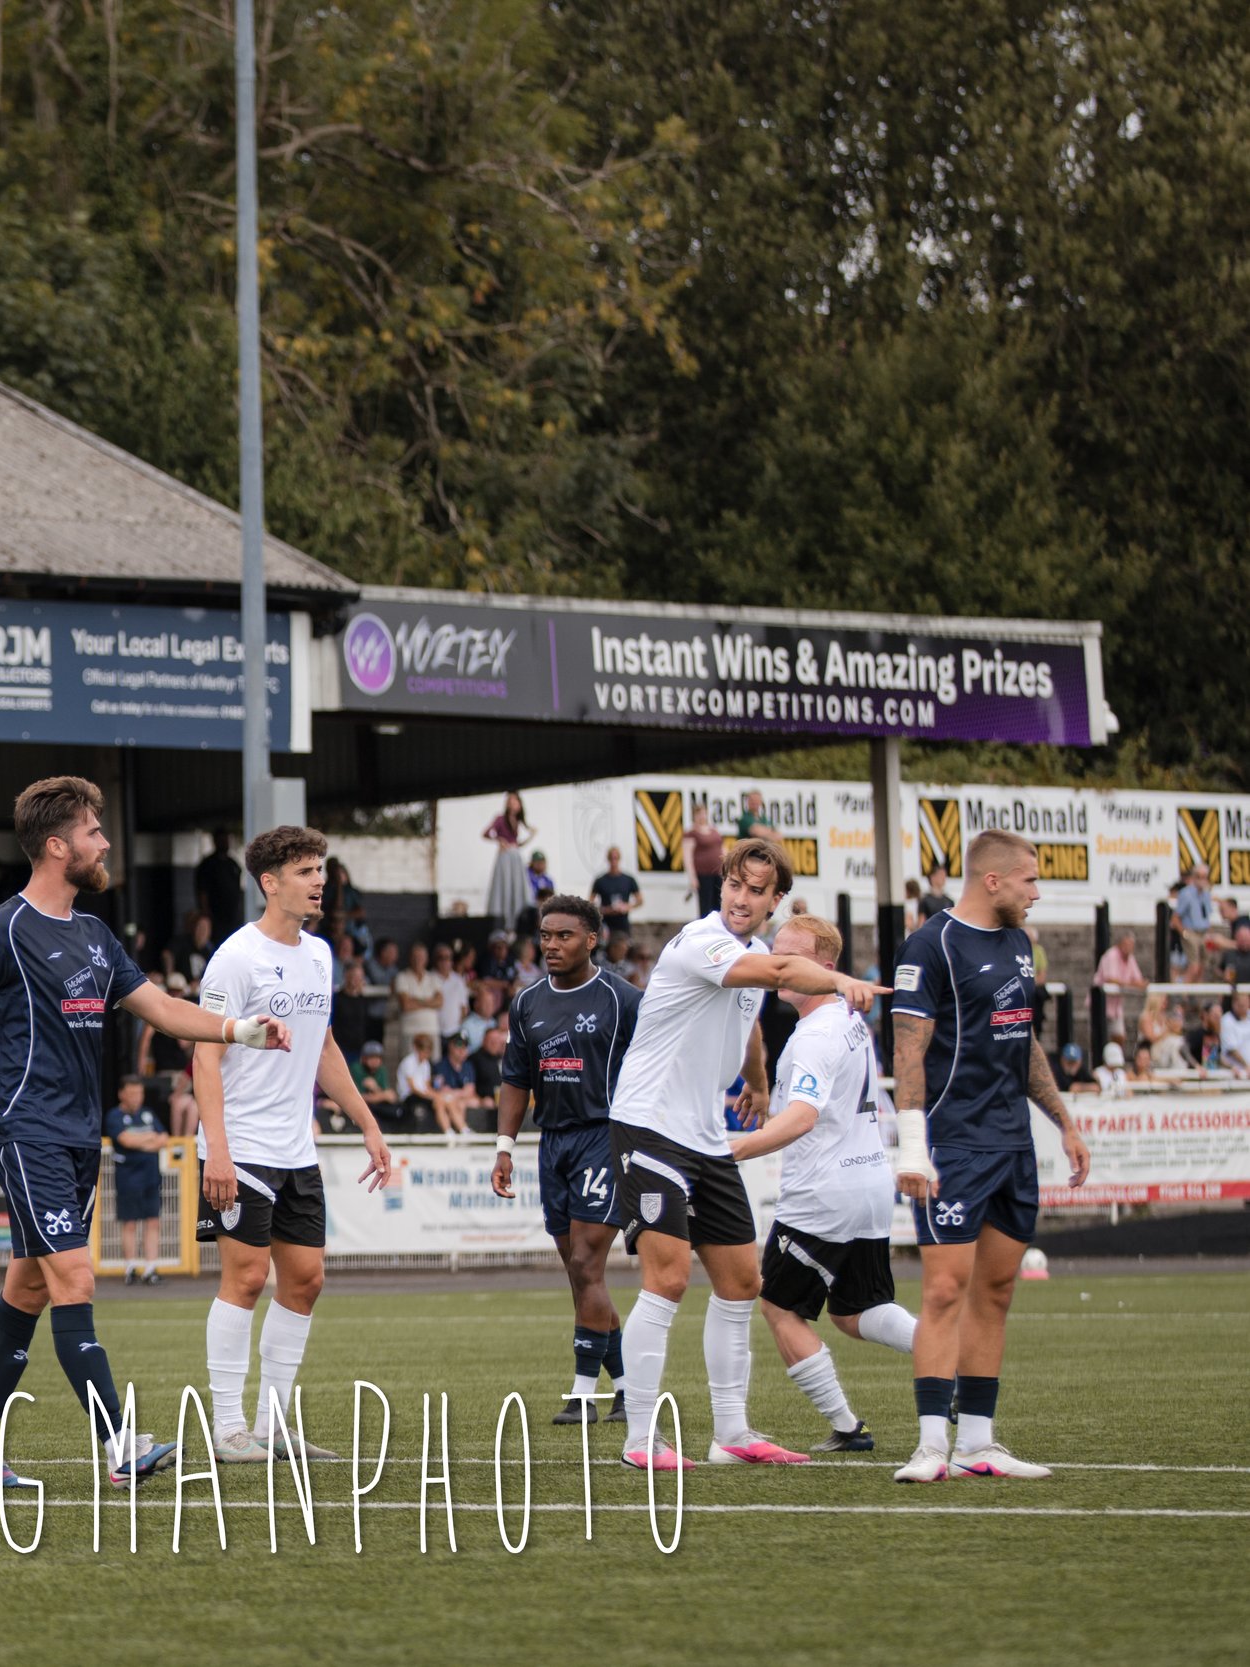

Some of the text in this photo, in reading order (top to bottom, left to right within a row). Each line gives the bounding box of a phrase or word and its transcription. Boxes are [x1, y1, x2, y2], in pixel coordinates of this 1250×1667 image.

[71, 628, 290, 666] Your Local Legal Exrts
[396, 614, 518, 678] VORTEX
[591, 626, 1054, 705] Instant Wins & Amazing Prizes
[406, 676, 508, 698] COMPETITIONS
[594, 682, 935, 728] VORTEXCOMPETITIONS.COM
[967, 798, 1087, 834] MacDonald
[66, 971, 92, 989] McArthur
[70, 985, 84, 998] Glen
[64, 1001, 90, 1012] Designer
[541, 1035, 567, 1051] McArthur
[1098, 1115, 1142, 1133] PARTS
[1147, 1113, 1158, 1130] &
[410, 1168, 469, 1186] Wealth
[583, 1166, 607, 1199] 14
